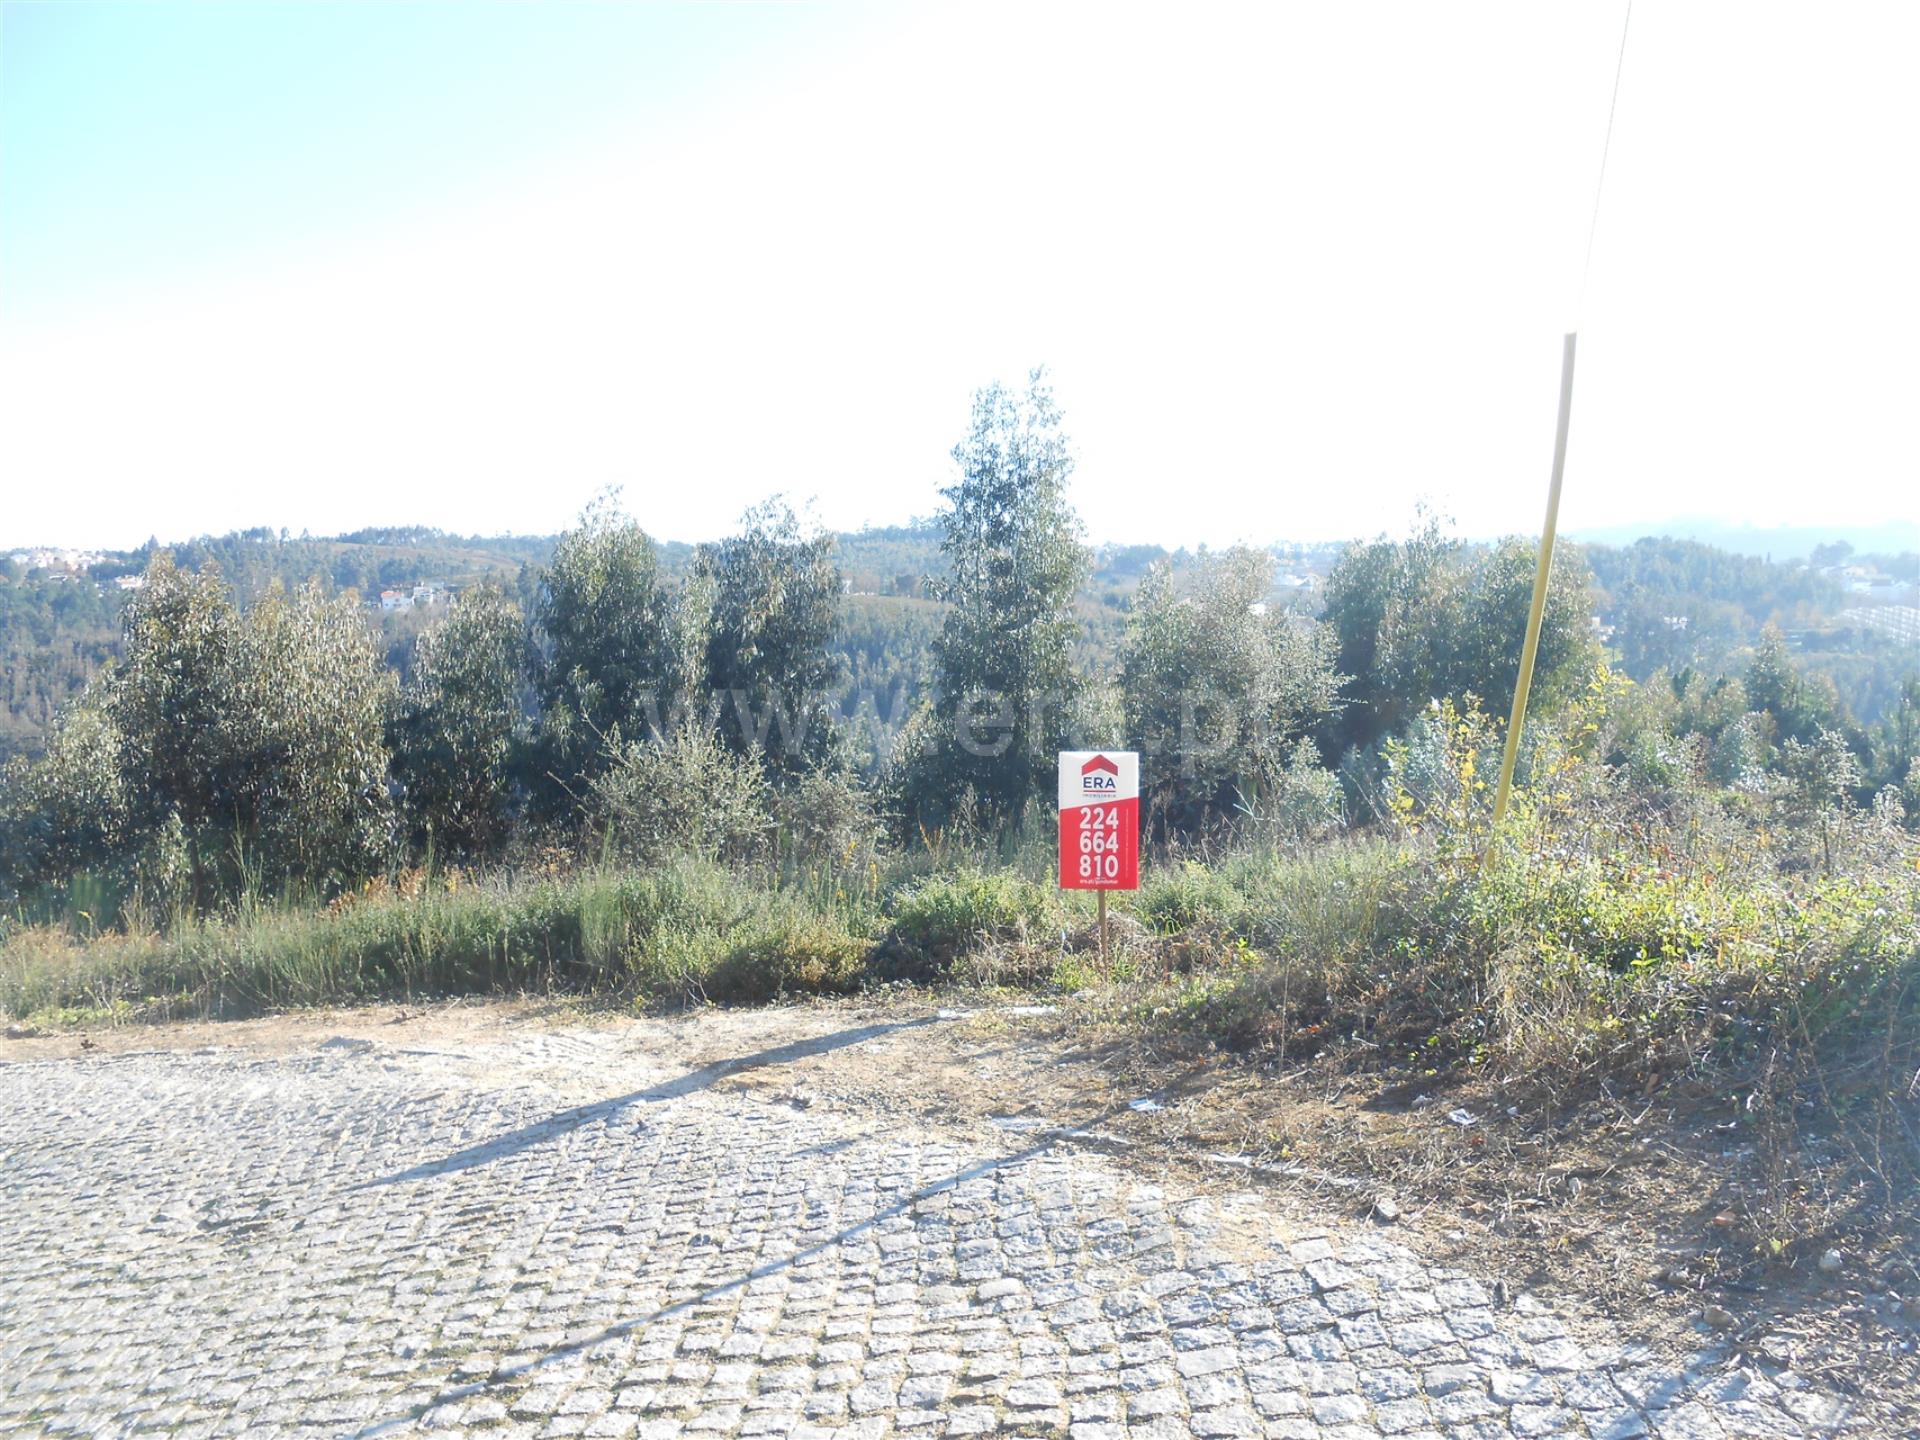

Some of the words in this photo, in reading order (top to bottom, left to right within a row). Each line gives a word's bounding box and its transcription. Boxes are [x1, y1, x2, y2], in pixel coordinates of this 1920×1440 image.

[1083, 777, 1116, 788] ERA
[1080, 807, 1119, 829] 224
[1080, 831, 1119, 853] 664
[1080, 855, 1119, 878] 810
